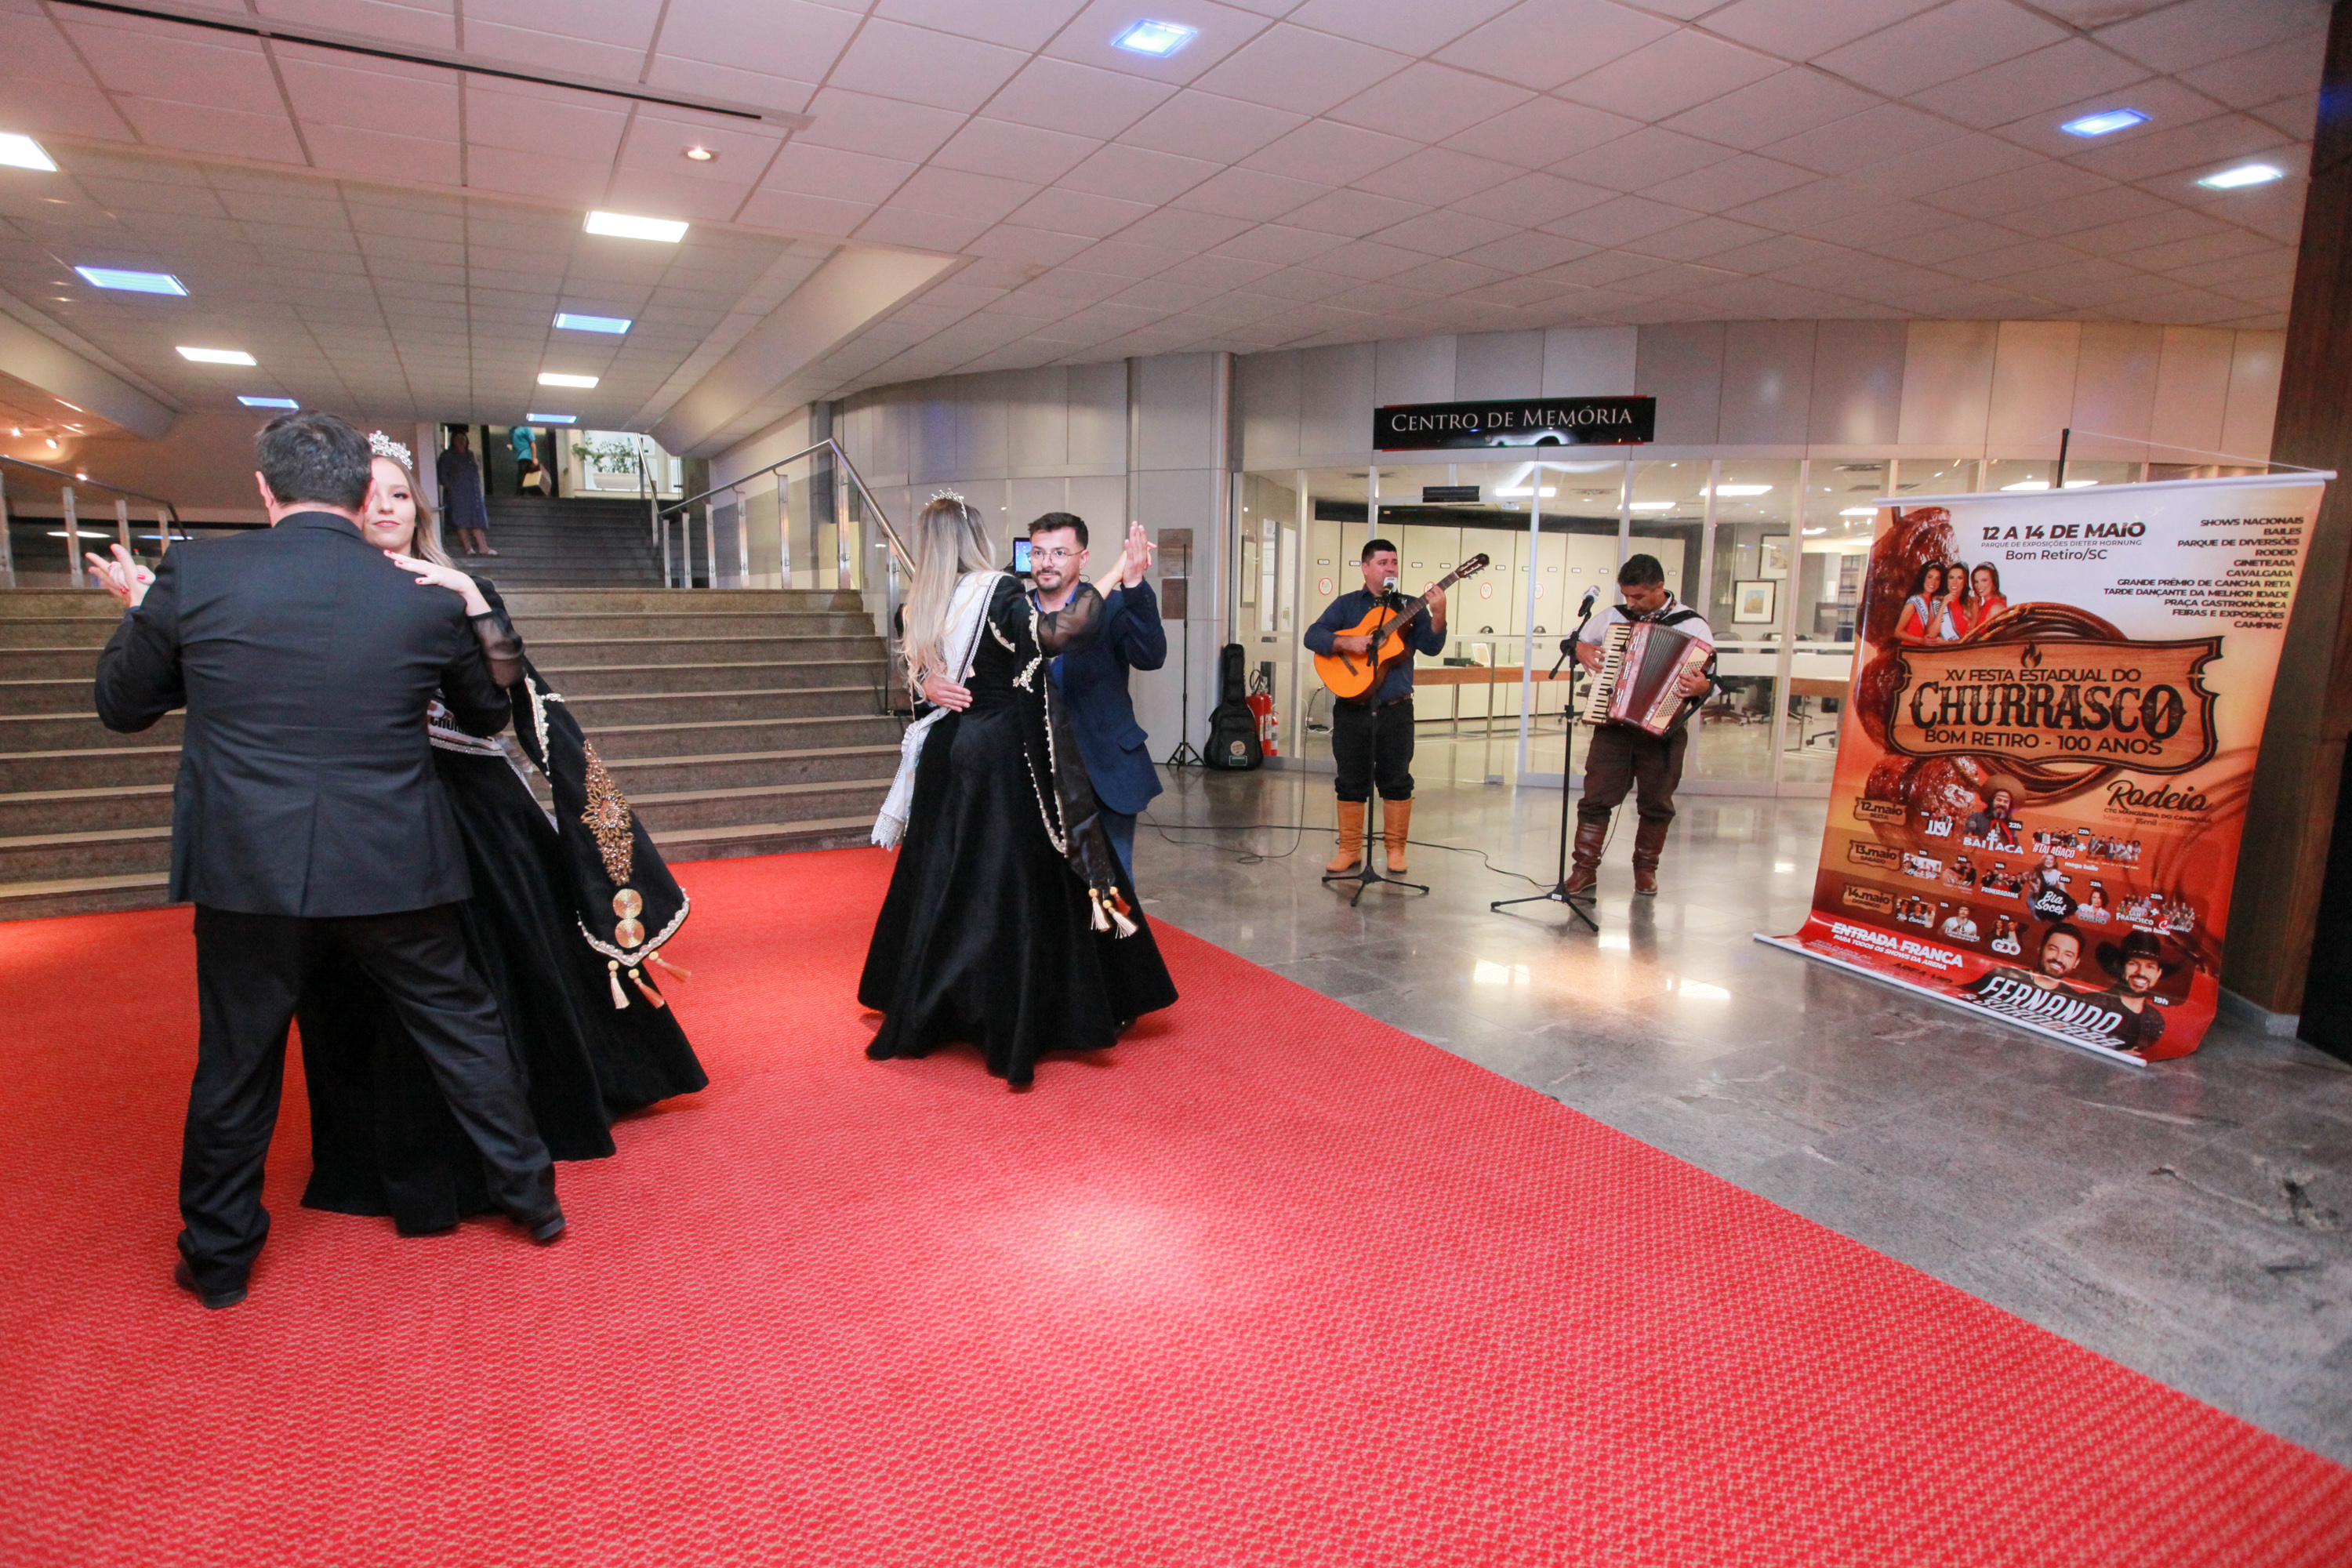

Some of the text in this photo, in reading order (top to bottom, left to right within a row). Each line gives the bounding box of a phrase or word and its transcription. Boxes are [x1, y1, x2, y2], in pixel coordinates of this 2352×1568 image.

[2200, 517, 2304, 527] SHOWS NACIONAIS
[1983, 522, 2146, 539] 12 A 14 DE MAIO
[2022, 539, 2067, 548] EXPOSIÇÕES
[2238, 536, 2300, 546] DIVERSÕES
[2005, 548, 2108, 561] Bom Retiro/SC
[2158, 577, 2194, 586] PRÊMIO
[2136, 588, 2187, 597] DANÇANTE
[2164, 599, 2286, 608] PRAÇA GASTRONÔMICA
[2220, 610, 2285, 620] EXPOSIÇÕES
[2234, 621, 2282, 630] CAMPING
[1945, 669, 2142, 682] XV FESTA ESTADUAL DO
[1909, 681, 2187, 739] CHURRASCO
[1925, 729, 1965, 745] BOM
[1971, 731, 2040, 748] RETIRO
[2057, 735, 2092, 751] 100
[2096, 738, 2163, 755] ANOS
[2107, 779, 2213, 811] Rodeio
[1861, 801, 1903, 815] 12.maio
[1855, 844, 1897, 860] 13.maio
[1848, 887, 1890, 904] 14.maio
[2043, 891, 2063, 904] Bia
[1852, 898, 1881, 909] DOMINGO
[2116, 913, 2154, 925] FRANCISCO
[1831, 922, 1897, 949] ENTRADA
[1900, 940, 1963, 967] FRANCA
[1833, 935, 1850, 943] PARA
[1852, 939, 1874, 949] TODOS
[1884, 949, 1910, 960] SHOWS
[1922, 960, 1947, 970] ARENA
[1978, 976, 2123, 1033] FERNANDO
[2154, 996, 2169, 1005] 19h
